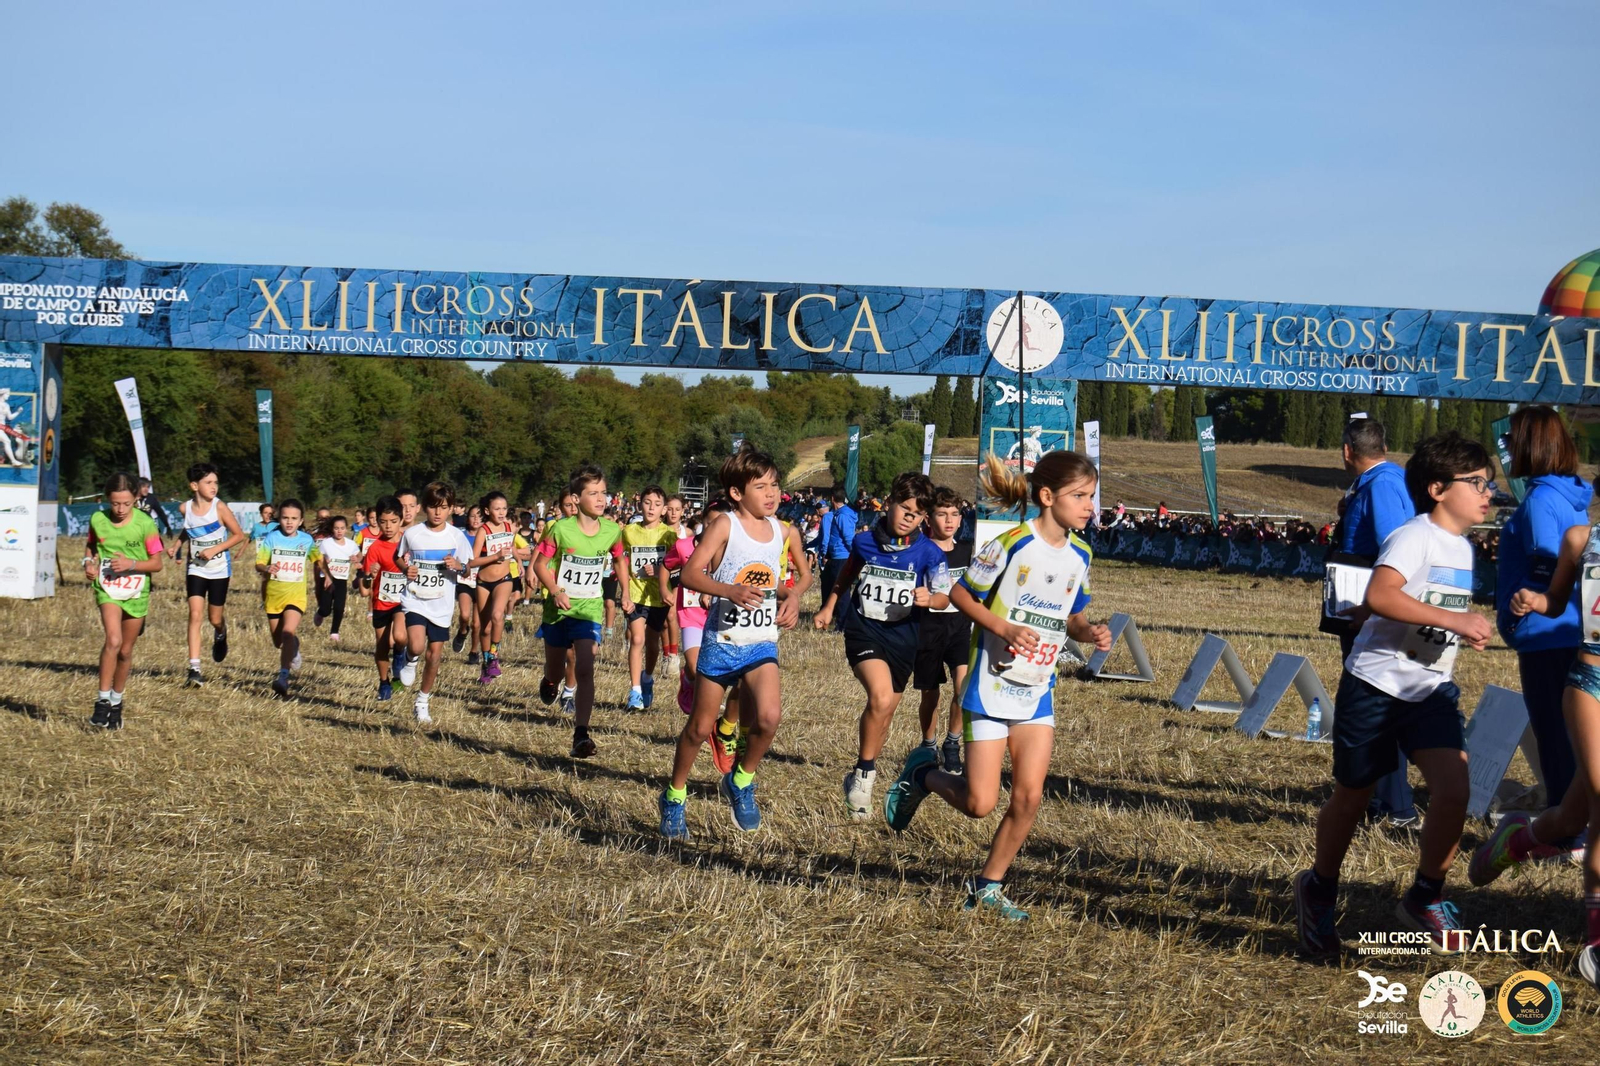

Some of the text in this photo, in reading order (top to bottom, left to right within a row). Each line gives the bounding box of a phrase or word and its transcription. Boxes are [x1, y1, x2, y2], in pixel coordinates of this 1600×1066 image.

[76, 286, 96, 298] DE
[98, 286, 189, 302] ANDALUCÍA
[411, 285, 534, 317] CROSS
[3, 297, 155, 315] DE CAMPO A TRAVÉS
[250, 278, 407, 333] XLIII
[37, 312, 124, 326] POR CLUBES
[590, 279, 890, 354] ITÁLICA
[411, 319, 579, 338] INTERNACIONAL
[1107, 307, 1267, 365] XLIII
[1271, 316, 1396, 350] CROSS
[248, 334, 549, 357] INTERNATIONAL CROSS COUNTRY
[1452, 315, 1600, 387] ITÁL
[0, 359, 31, 369] Sevilla
[1271, 350, 1440, 373] INTERNACIONAL
[1105, 362, 1409, 392] INTERNATIONAL CROSS COUNTRY
[1031, 388, 1064, 398] Diputación
[1031, 396, 1064, 406] Sevilla
[329, 565, 349, 574] 4457
[563, 569, 600, 586] 4172
[873, 569, 901, 579] ITÁLICA
[102, 574, 142, 590] 4427
[383, 582, 406, 594] 412
[413, 574, 445, 588] 4296
[861, 583, 910, 606] 4116
[1018, 593, 1063, 611] Chipiona
[724, 608, 772, 628] 4305
